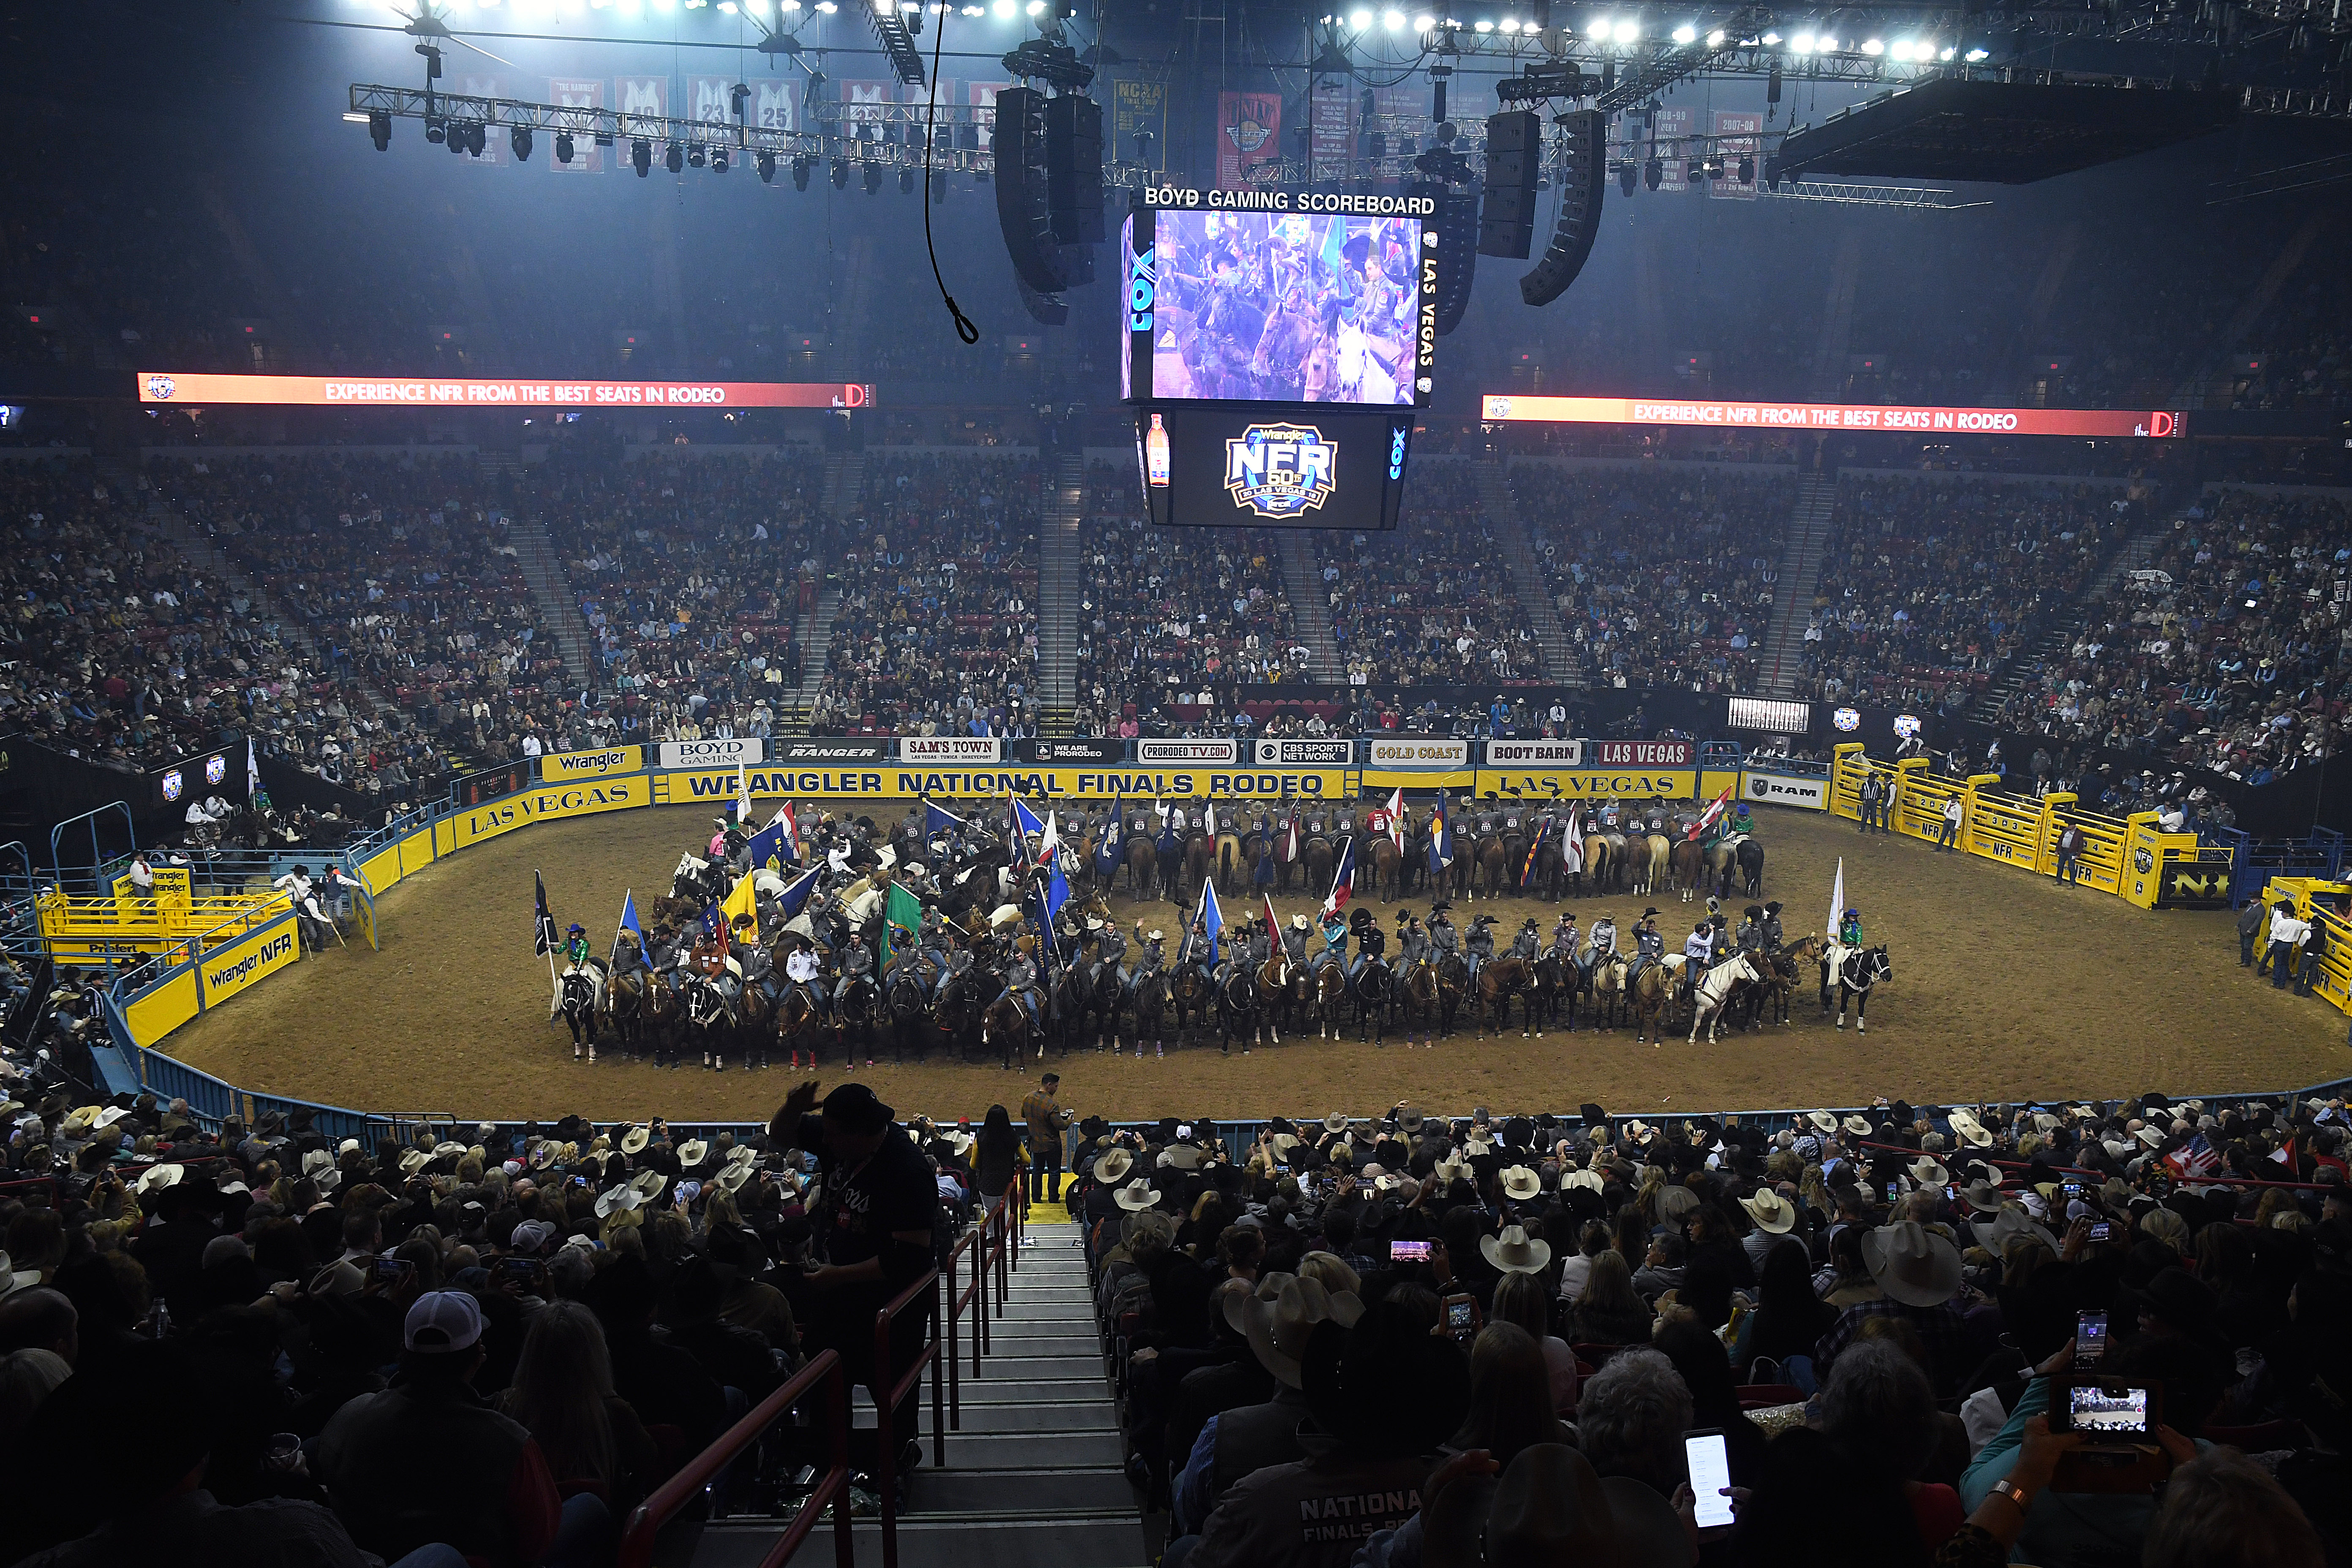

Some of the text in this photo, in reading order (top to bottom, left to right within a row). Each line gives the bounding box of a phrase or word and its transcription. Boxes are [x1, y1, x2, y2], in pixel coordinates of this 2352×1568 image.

[1119, 83, 1161, 98] NCAA
[702, 104, 725, 124] 23
[764, 107, 787, 128] 25
[1723, 120, 1754, 131] 2007-08
[1145, 188, 1435, 214] BOYD GAMING SCOREBOARD
[1423, 259, 1437, 294] LAS
[1132, 247, 1156, 331] COX
[1420, 303, 1435, 366] VEGAS
[326, 383, 726, 403] EXPERIENCE NFR FROM THE BEST SEATS IN RODEO
[832, 384, 865, 408] the D
[1634, 405, 2017, 430] EXPERIENCE NFR FROM THE BEST SEATS IN RODEO
[2134, 411, 2173, 437] the D
[1260, 429, 1307, 444] Wrangler
[1389, 427, 1406, 480] COX
[1230, 443, 1331, 482] NFR
[1254, 486, 1272, 495] LAS
[1275, 486, 1306, 496] VEGAS
[1759, 703, 1798, 713] TOYOTA
[1834, 711, 1860, 723] NFR
[1895, 719, 1920, 732] NFR
[679, 742, 744, 756] BOYD
[789, 749, 876, 757] RANGER
[909, 741, 994, 754] SAM'S TOWN
[1147, 747, 1188, 756] PRORODEO
[1283, 744, 1347, 753] CBS SPORTS
[1376, 746, 1462, 759] GOLD COAST
[1494, 747, 1575, 759] BOOT BARN
[1603, 744, 1685, 763] LAS VEGAS
[559, 751, 626, 773] Wrangler
[680, 755, 743, 765] GAMING
[1283, 752, 1335, 761] NETWORK
[207, 760, 225, 776] NFR
[163, 775, 182, 792] NFR
[688, 773, 882, 796] WRANGLER
[898, 773, 1065, 793] NATIONAL
[1077, 774, 1194, 793] FINALS
[1210, 774, 1323, 793] RODEO
[1499, 776, 1675, 793] LAS VEGAS
[1771, 784, 1817, 798] RAM
[469, 784, 630, 837] LAS VEGAS
[1992, 817, 1998, 825] 3
[2012, 822, 2018, 830] 3
[1922, 822, 1940, 838] NFR
[2138, 832, 2156, 844] Wrangler
[1974, 840, 2033, 861] Wrangler NFR Wrangler
[2092, 844, 2099, 852] 4
[2134, 850, 2153, 867] NFR
[2076, 865, 2092, 882] FR
[2096, 874, 2115, 884] Wrangler
[2273, 885, 2297, 900] Wrangler
[2331, 945, 2337, 954] 5
[209, 933, 292, 991] Wrangler NFR
[1299, 1489, 1423, 1521] NATIONA
[1303, 1522, 1374, 1543] FINALS
